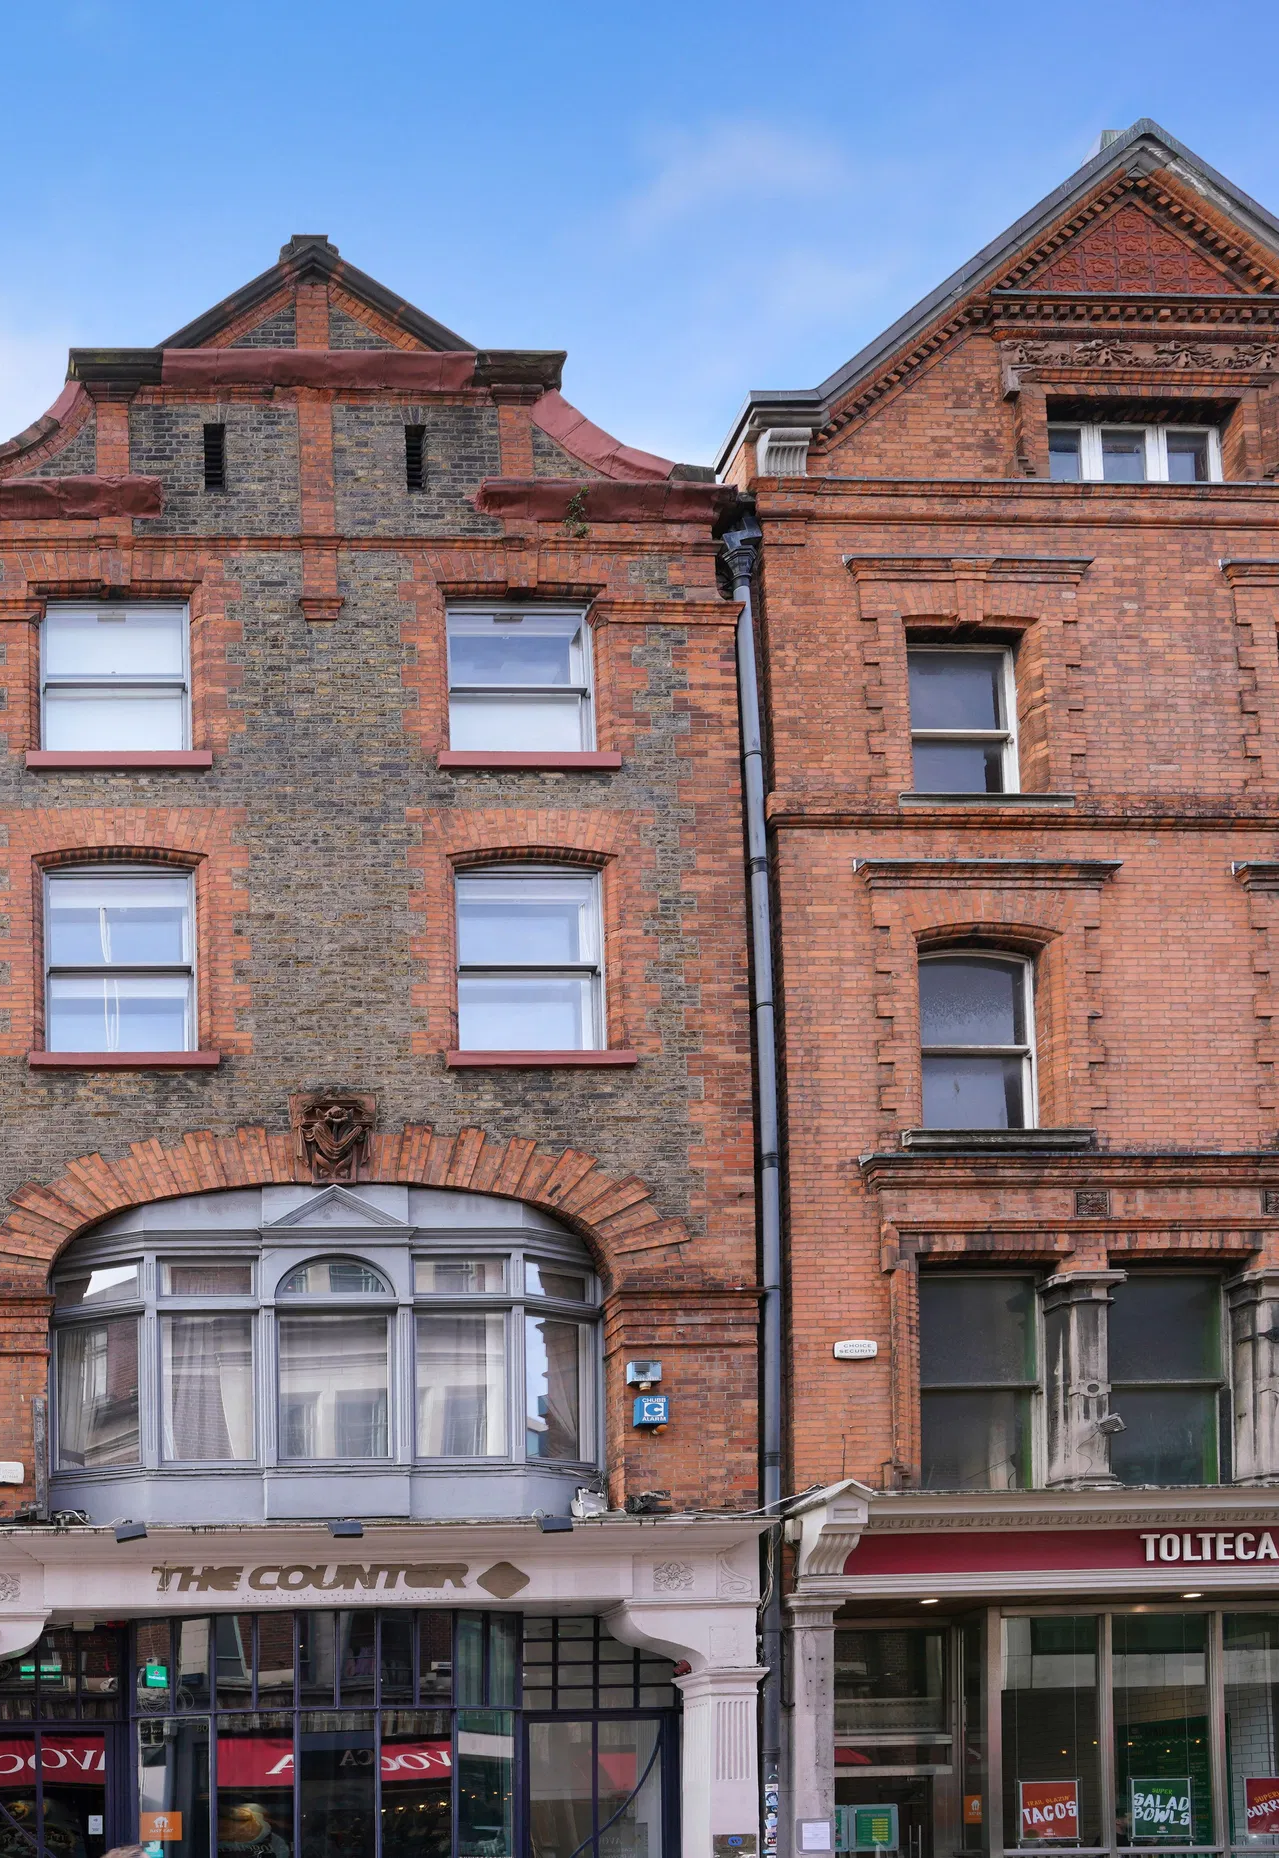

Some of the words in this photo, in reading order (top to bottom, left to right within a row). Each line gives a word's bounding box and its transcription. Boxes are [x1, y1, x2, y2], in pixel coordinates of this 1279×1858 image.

[1140, 1532, 1279, 1561] TOLTECA
[151, 1565, 244, 1592] THE
[248, 1562, 470, 1591] COUNTER
[1022, 1801, 1077, 1825] TACOS
[1133, 1793, 1189, 1811] SALAD
[1134, 1806, 1190, 1825] BOWLS
